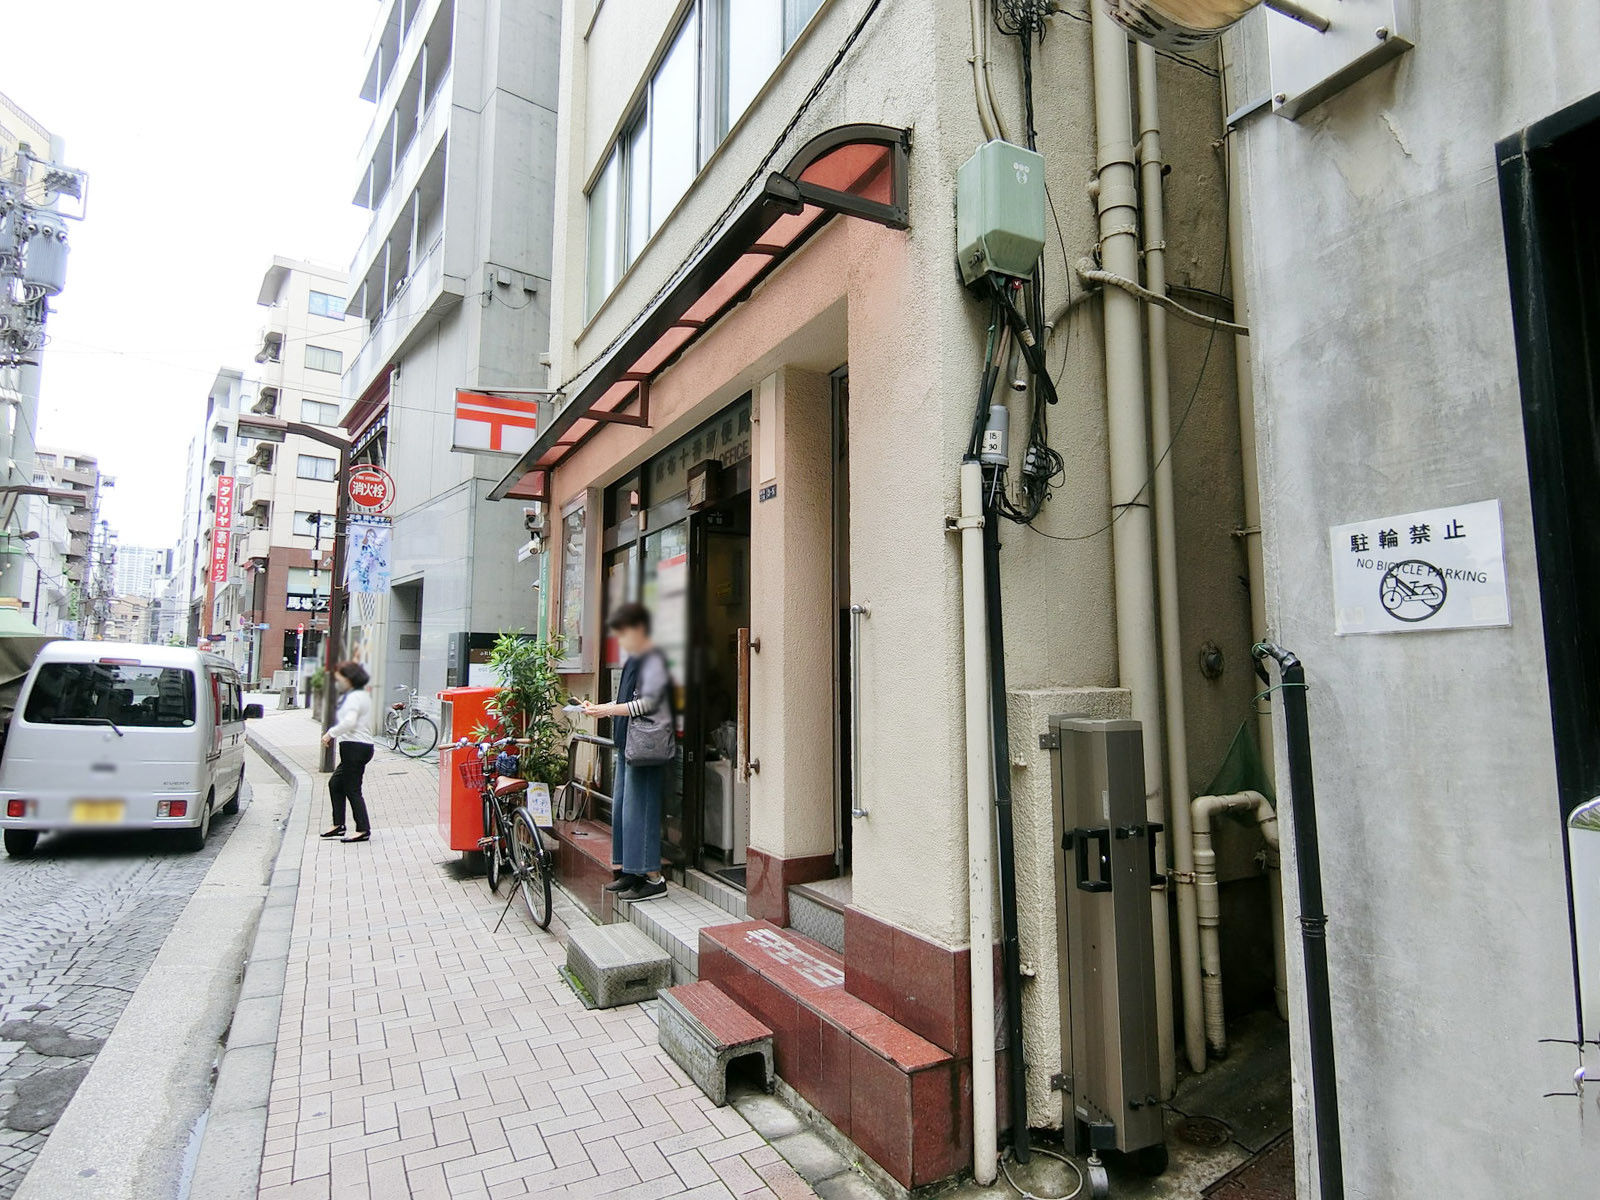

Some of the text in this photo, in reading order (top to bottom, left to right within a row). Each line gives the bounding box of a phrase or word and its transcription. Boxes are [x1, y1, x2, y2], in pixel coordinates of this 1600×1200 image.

[352, 480, 385, 498] 消火栓
[217, 486, 230, 527] タマリヤ
[1350, 519, 1466, 553] 駐輪禁止
[1356, 558, 1488, 584] NO BICYCLE PARKING
